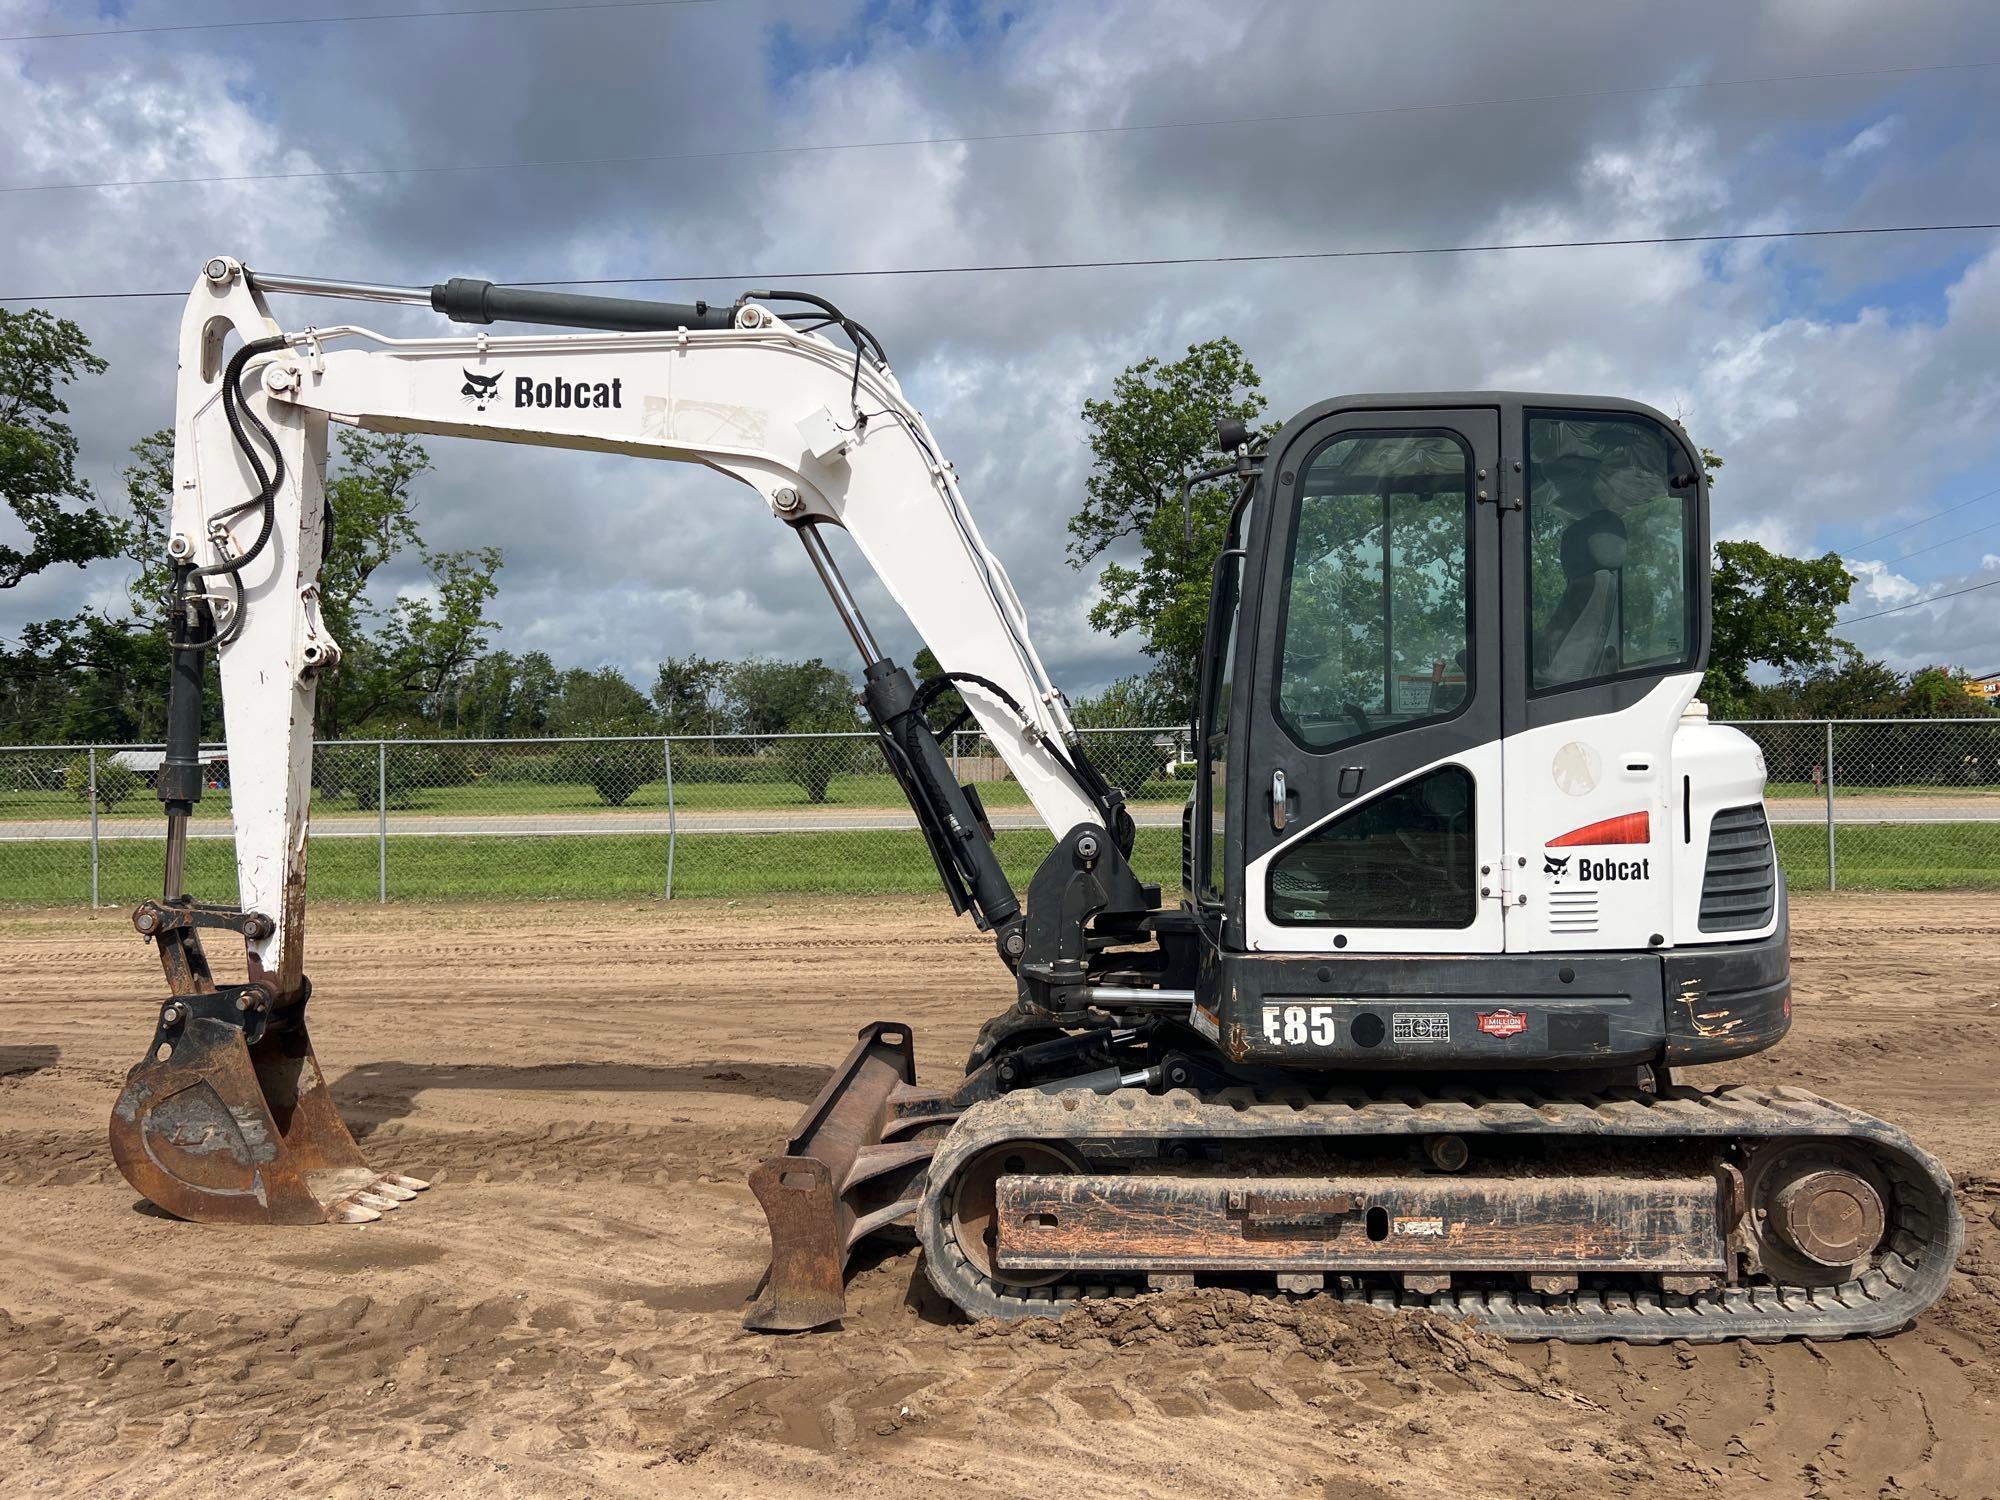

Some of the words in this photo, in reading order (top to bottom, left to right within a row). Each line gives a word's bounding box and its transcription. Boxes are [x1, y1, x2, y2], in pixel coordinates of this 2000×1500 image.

[515, 376, 622, 409] Bobcat
[1579, 858, 1650, 881] Bobcat
[1262, 1006, 1335, 1047] E85
